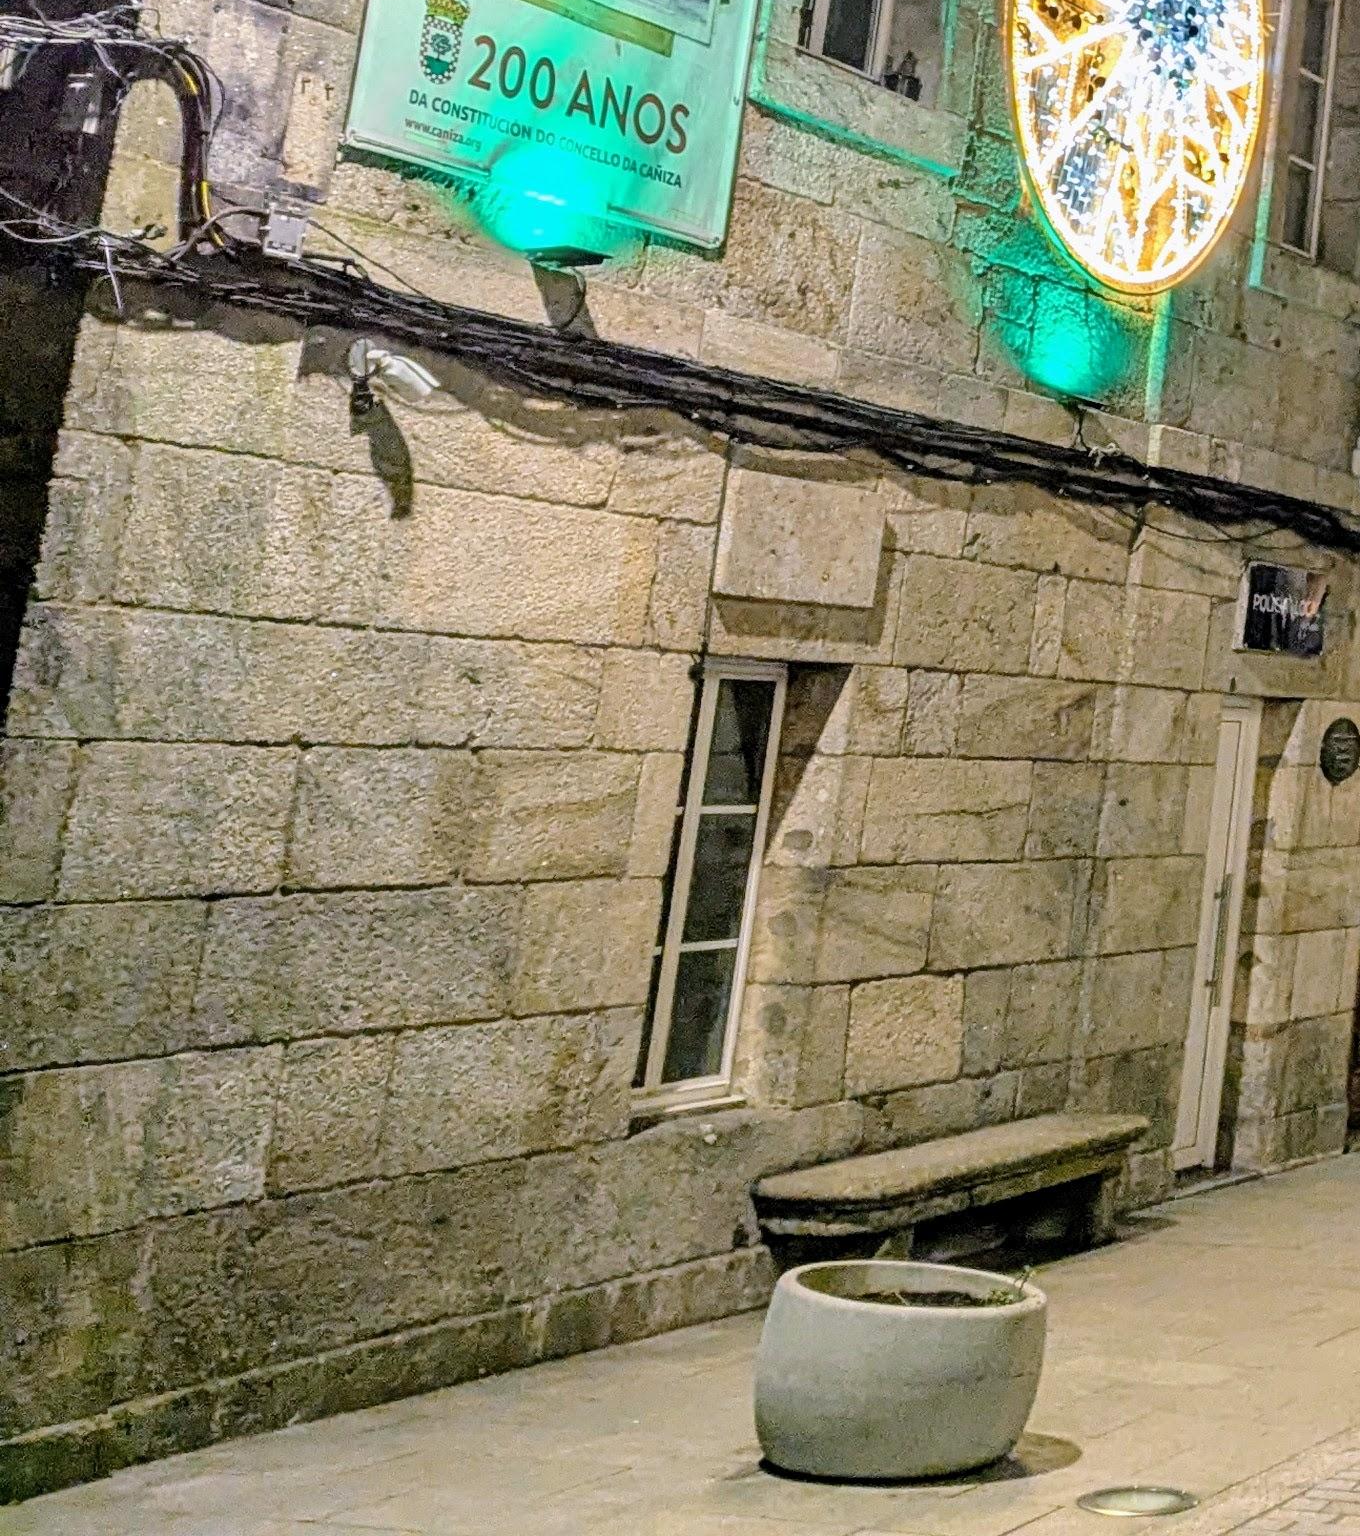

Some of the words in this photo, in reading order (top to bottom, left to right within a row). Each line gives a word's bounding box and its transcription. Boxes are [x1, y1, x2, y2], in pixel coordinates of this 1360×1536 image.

[404, 117, 483, 153] www.caniza.org
[409, 89, 428, 109] DA
[431, 96, 533, 141] CONSTITUCIÓN
[535, 128, 556, 146] DO
[559, 136, 621, 168] CONCELLO
[622, 156, 638, 174] DA
[639, 163, 682, 188] CAÑIZA
[467, 34, 557, 110] 200
[564, 68, 691, 155] ANOS
